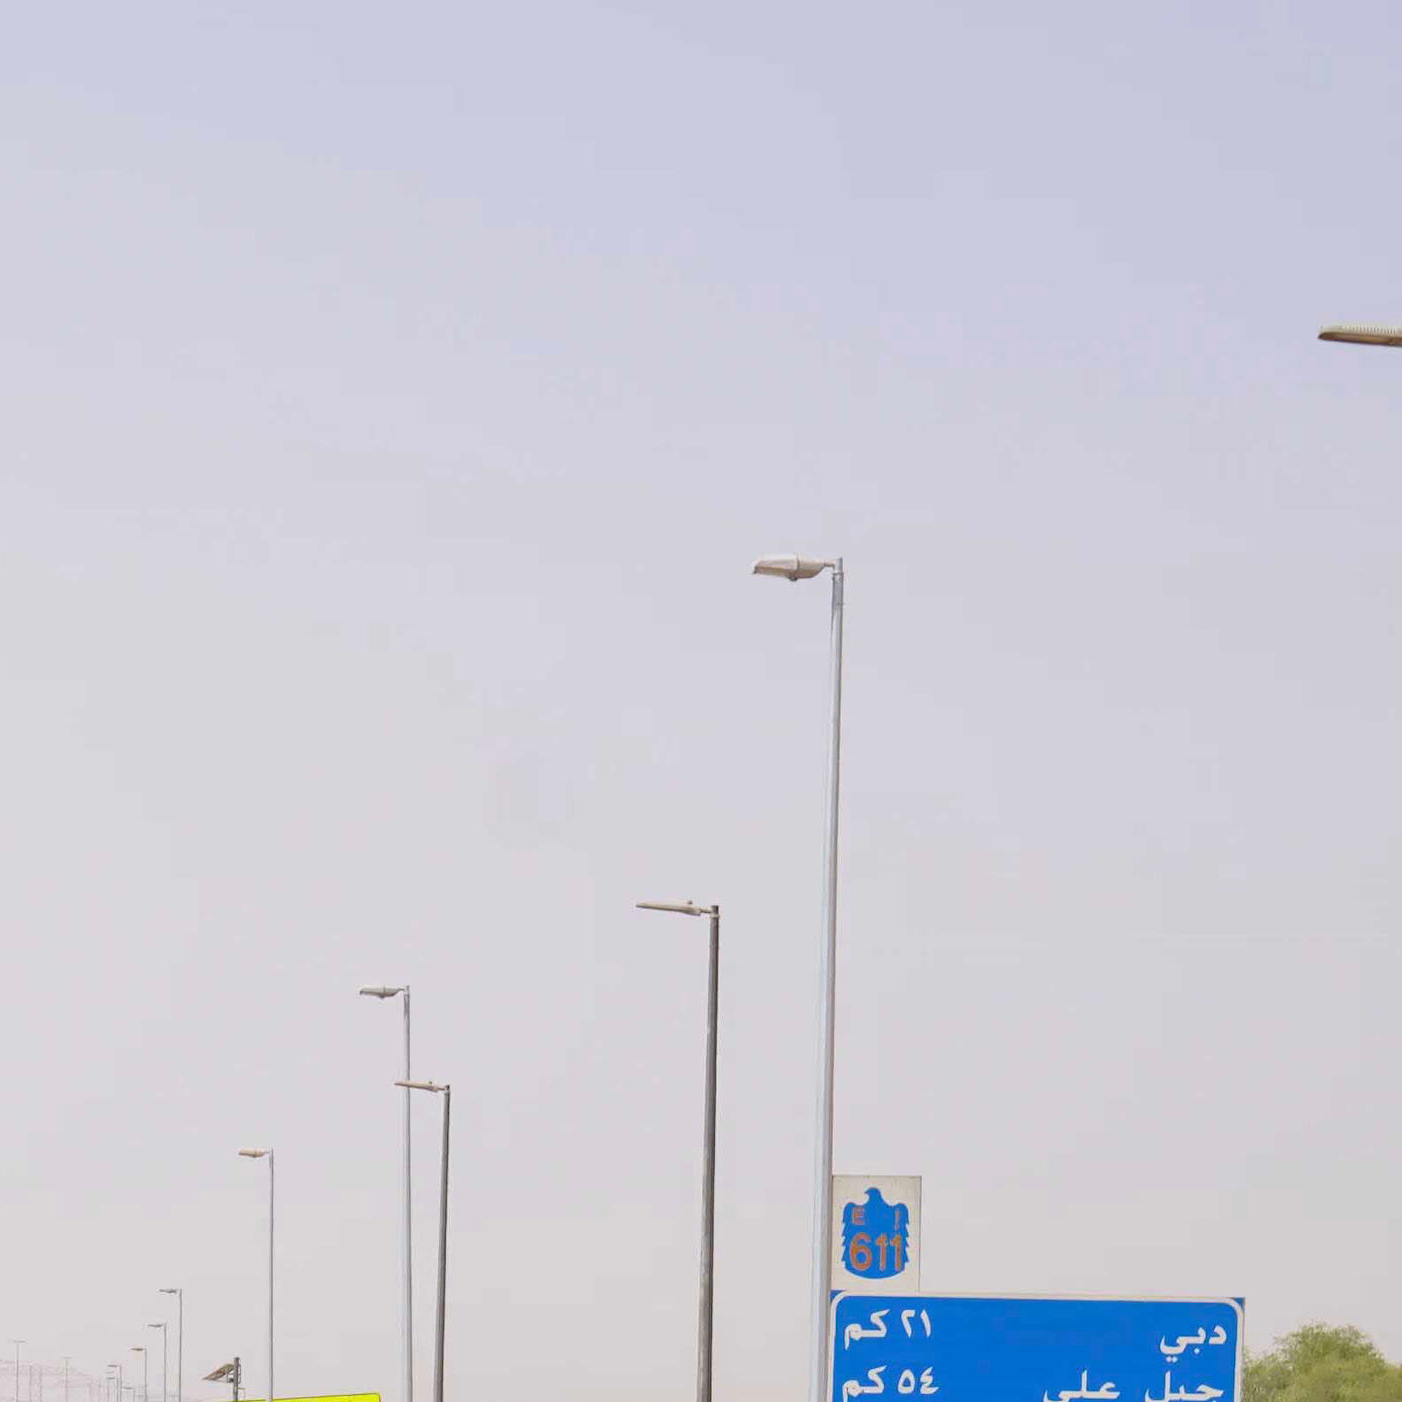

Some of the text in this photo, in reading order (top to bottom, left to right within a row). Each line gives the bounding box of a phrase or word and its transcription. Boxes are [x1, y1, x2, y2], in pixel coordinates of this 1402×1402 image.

[849, 1231, 902, 1272] 611
[845, 1310, 1226, 1362] دبي ٢١ كم
[898, 1368, 938, 1394] ٥٤
